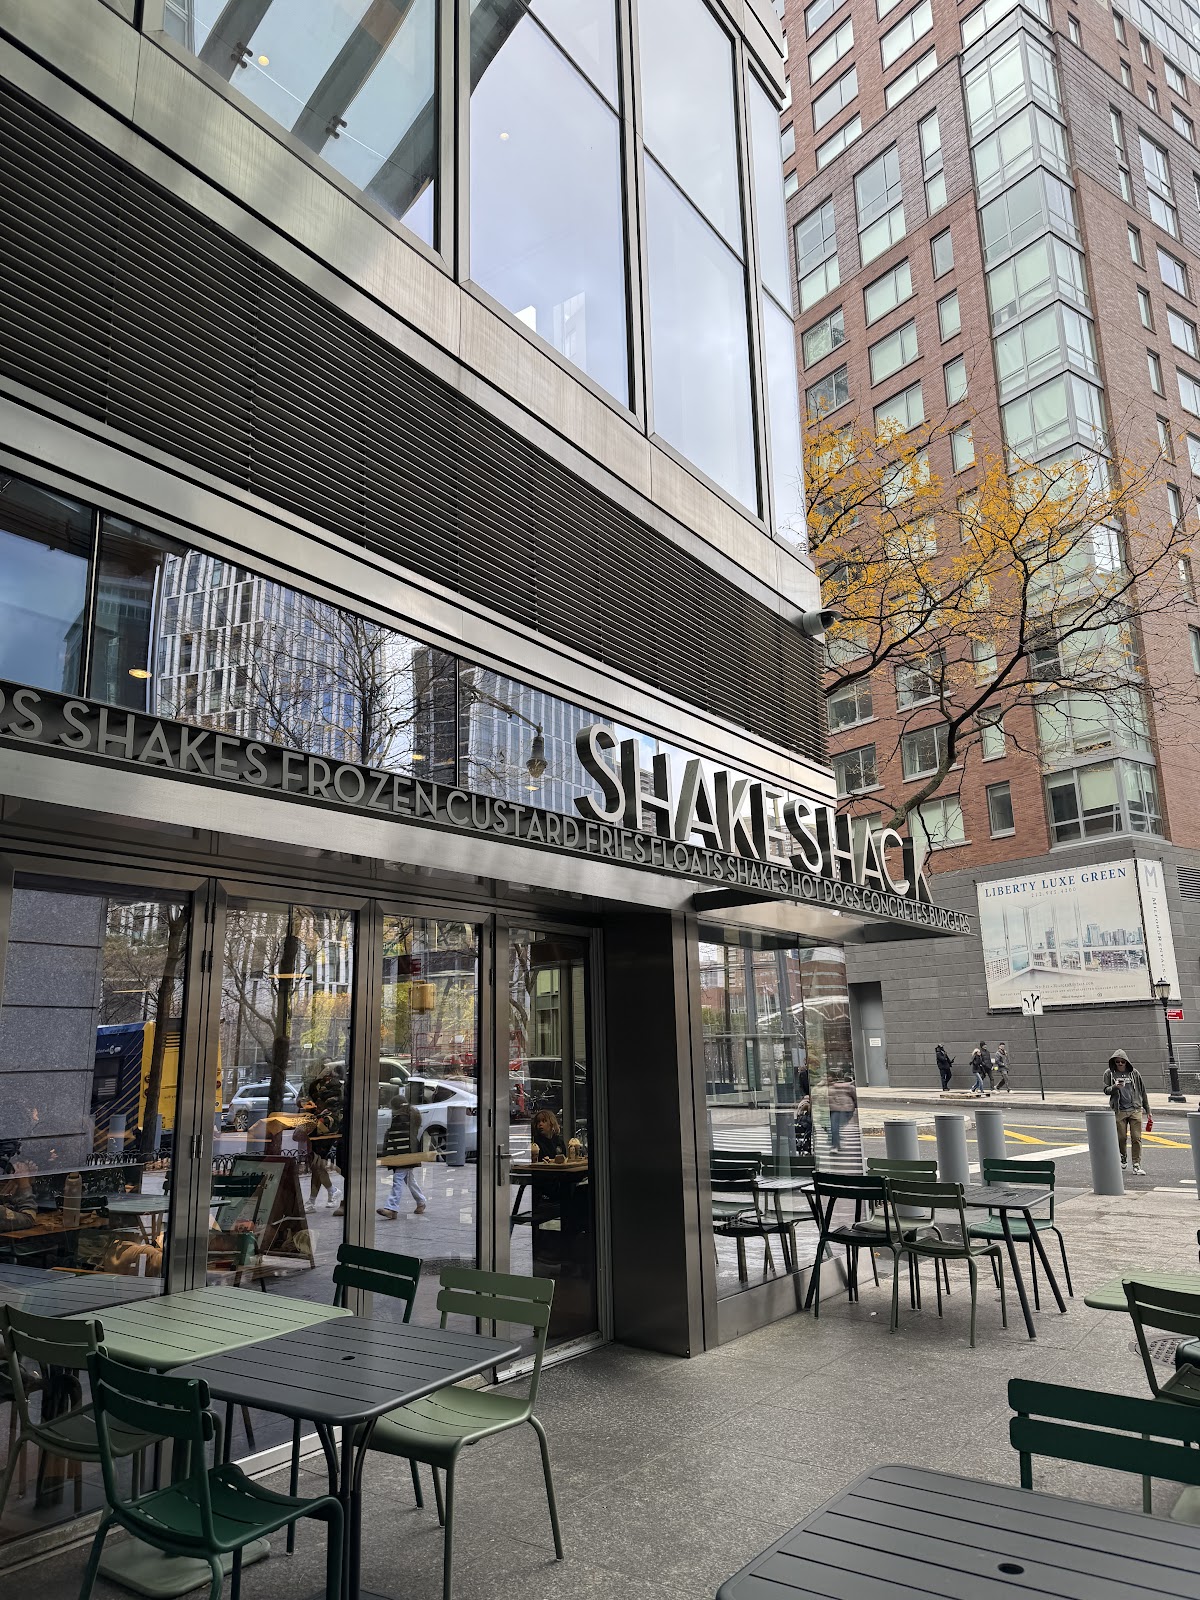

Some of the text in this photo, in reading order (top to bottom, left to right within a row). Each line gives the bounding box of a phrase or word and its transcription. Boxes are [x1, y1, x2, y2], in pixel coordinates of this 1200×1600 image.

[58, 700, 268, 785] SHAKES
[281, 752, 438, 820] FROZEN
[446, 790, 580, 848] CUSTARD
[586, 823, 646, 863] FRIES
[651, 838, 724, 879] FLOATS
[727, 858, 789, 893] SHAKES
[791, 871, 822, 898] HOT
[824, 879, 861, 909] DOGS
[862, 889, 928, 923] CONCRETES
[929, 906, 971, 933] BURGERS
[985, 868, 1127, 898] LIBERTY LUXE GREEN
